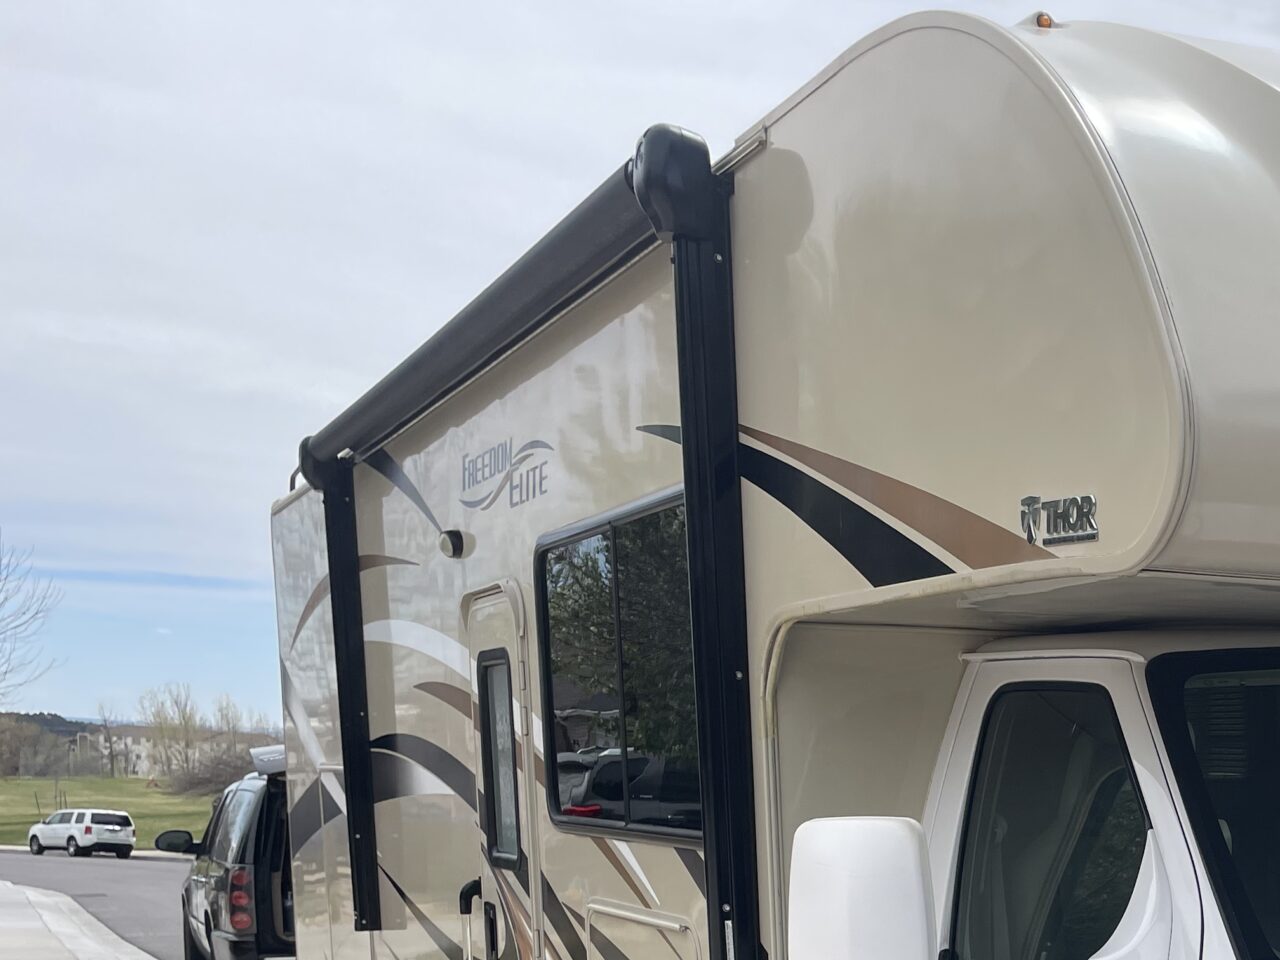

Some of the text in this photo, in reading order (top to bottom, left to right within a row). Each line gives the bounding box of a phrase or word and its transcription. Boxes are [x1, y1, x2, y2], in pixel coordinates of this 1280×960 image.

[462, 437, 513, 493] FREEDOM
[509, 460, 549, 509] ELITE
[1041, 494, 1098, 535] THOR
